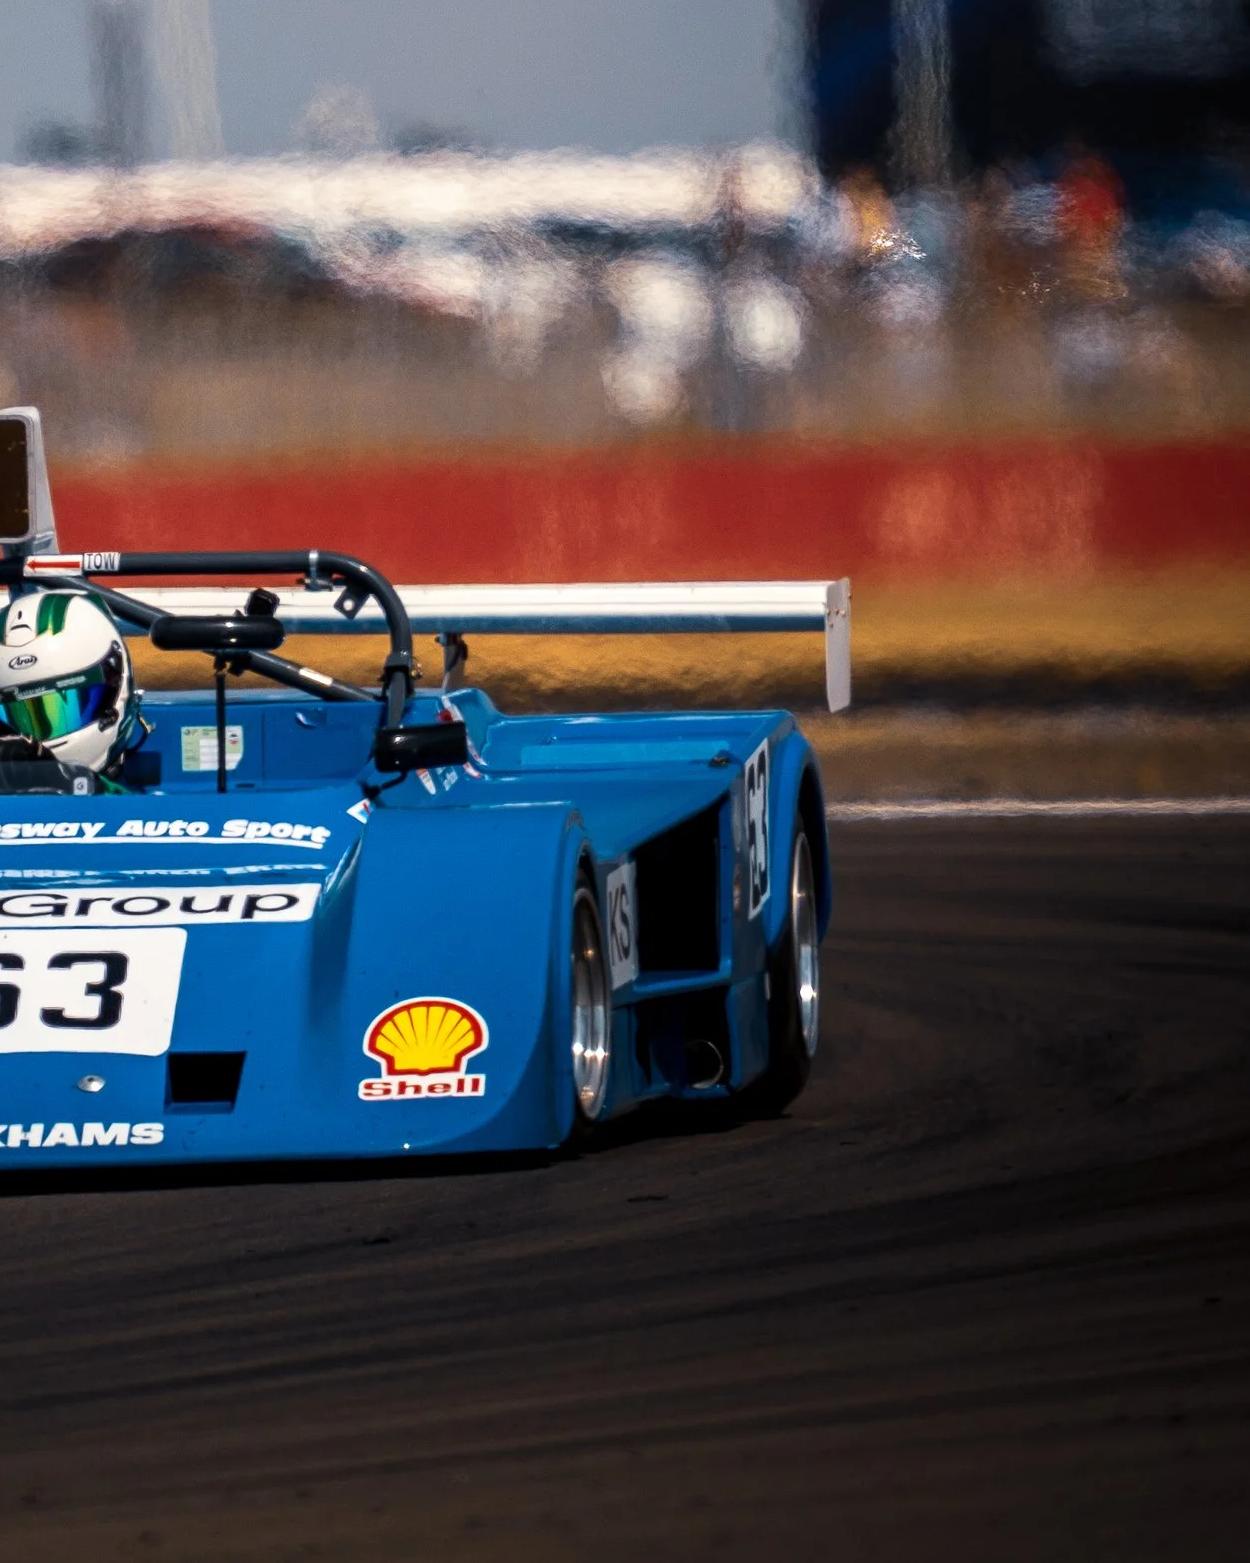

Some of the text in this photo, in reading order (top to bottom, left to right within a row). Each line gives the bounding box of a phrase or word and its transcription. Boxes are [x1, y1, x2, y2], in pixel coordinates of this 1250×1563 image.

[85, 552, 117, 570] TOW
[116, 819, 209, 837] Auto
[221, 819, 331, 843] Sport
[747, 749, 768, 910] 63
[608, 883, 630, 966] KS
[362, 1077, 481, 1097] Shell
